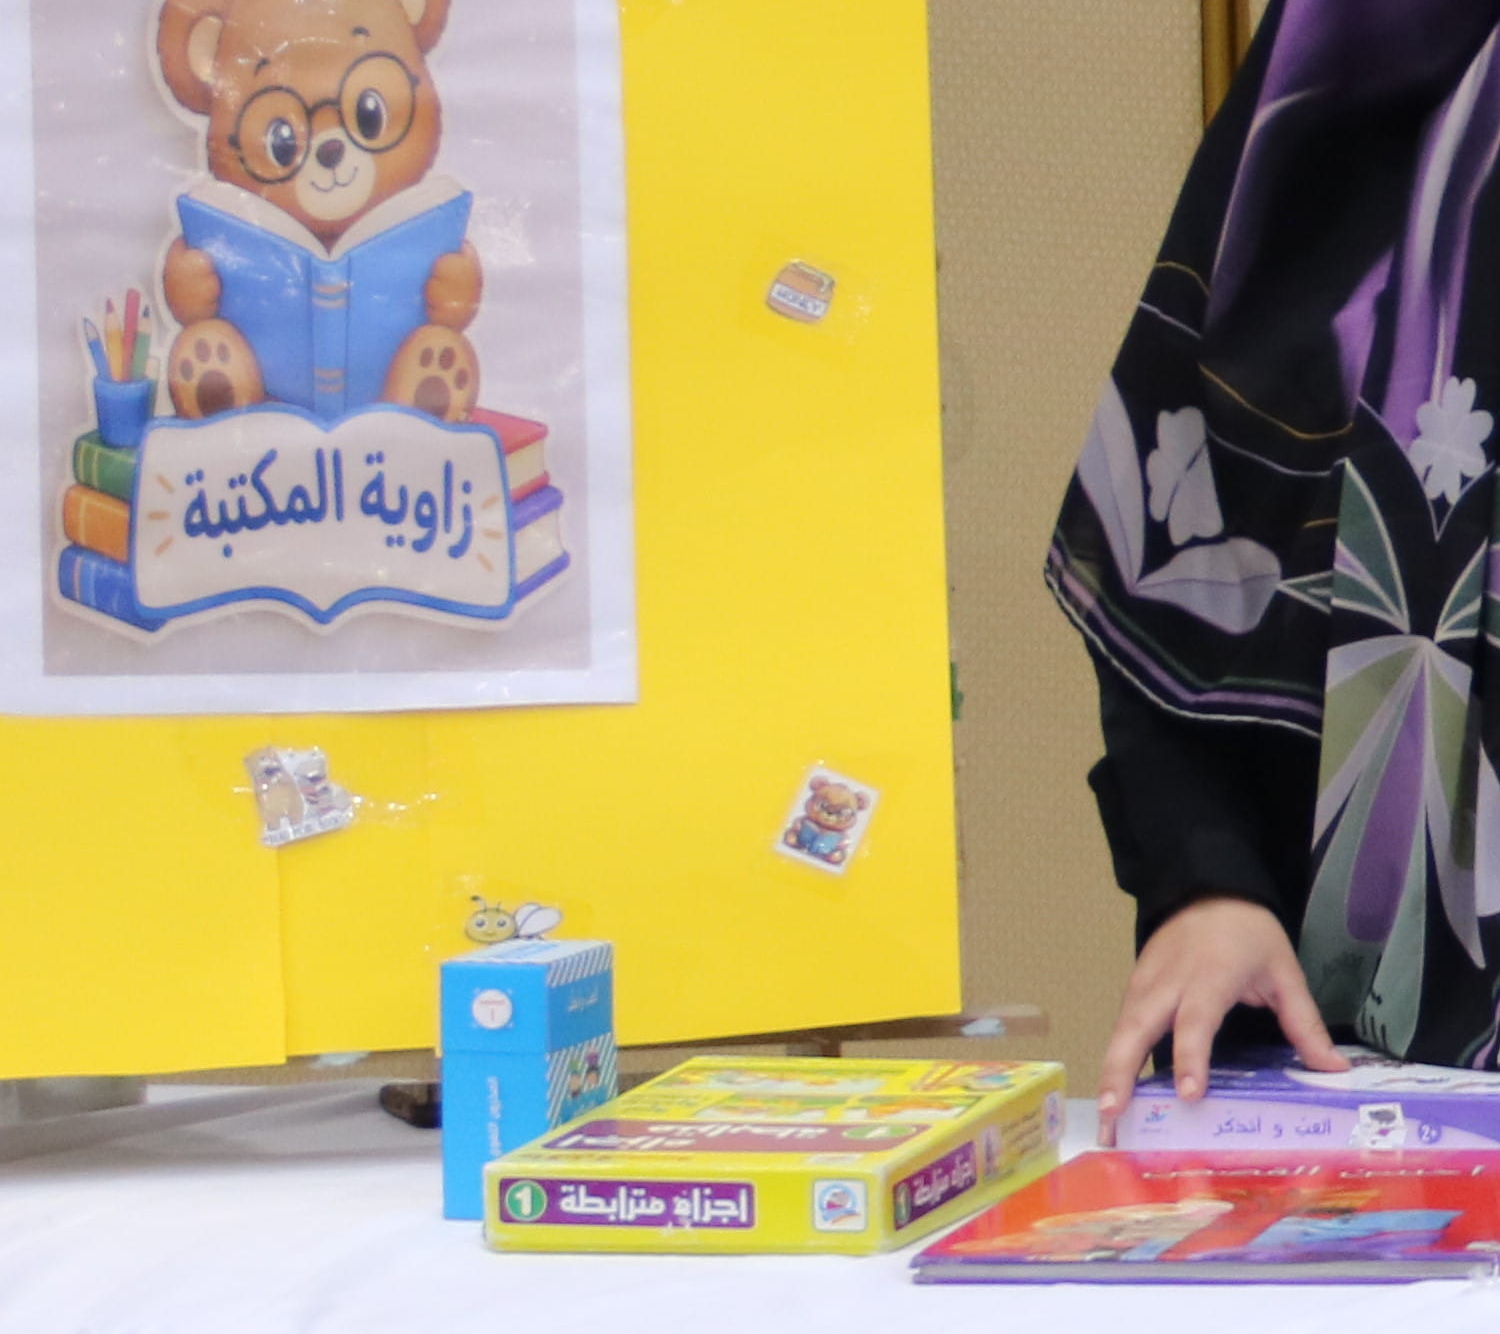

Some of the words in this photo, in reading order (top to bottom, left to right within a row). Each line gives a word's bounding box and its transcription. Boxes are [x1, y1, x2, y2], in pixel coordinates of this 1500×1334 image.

[183, 447, 345, 559] المكتبة
[360, 450, 474, 560] زاوية
[514, 1185, 533, 1217] 1
[559, 1184, 667, 1223] مترابطة
